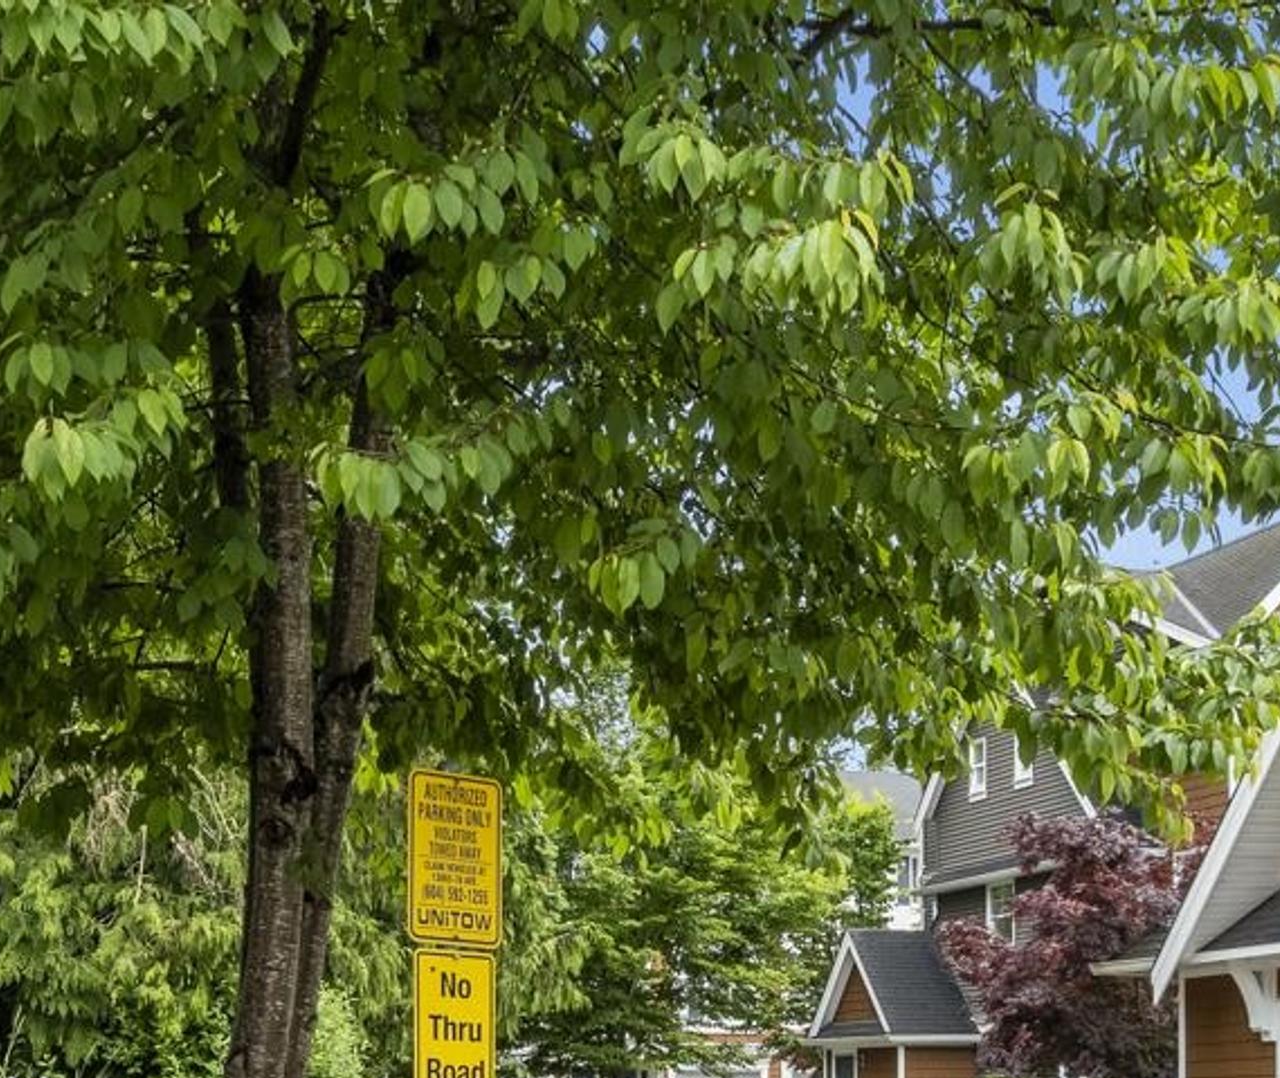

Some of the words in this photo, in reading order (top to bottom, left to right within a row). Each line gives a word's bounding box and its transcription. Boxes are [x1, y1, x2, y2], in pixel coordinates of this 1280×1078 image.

[424, 782, 487, 808] AUTHORIZED
[418, 801, 463, 826] PARKING
[465, 807, 492, 829] ONLY
[434, 825, 477, 844] VIOLATORS
[440, 970, 471, 999] No
[428, 1013, 482, 1042] Thru
